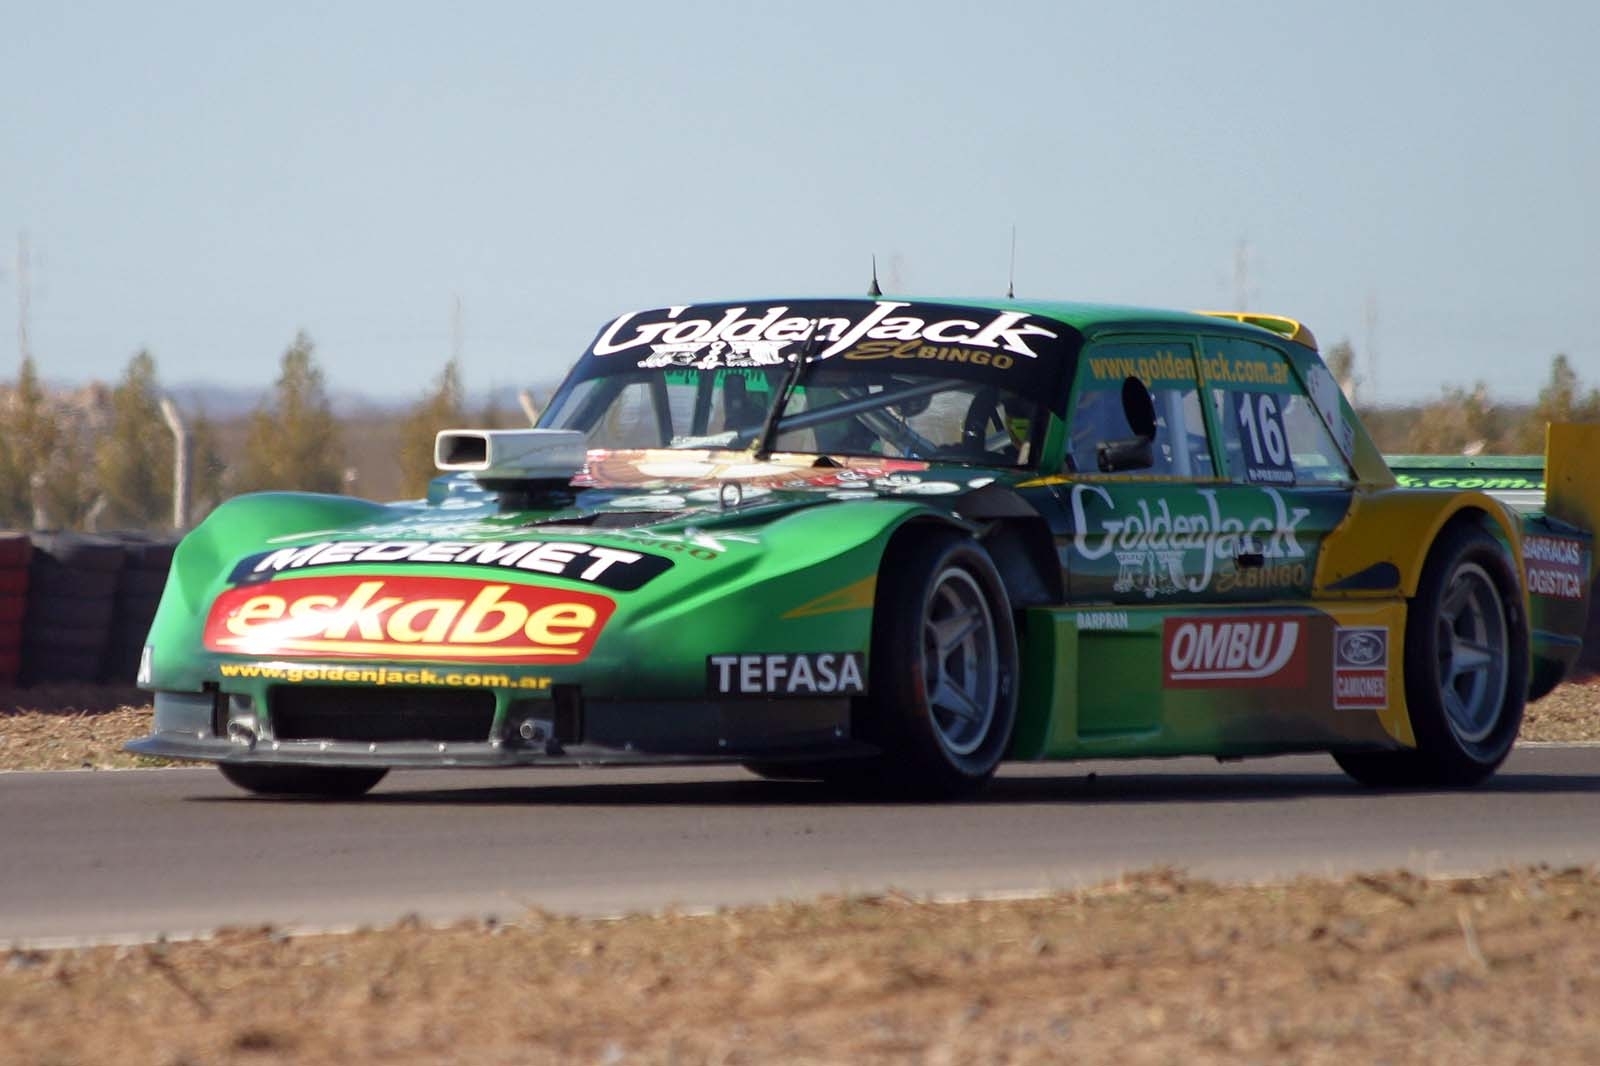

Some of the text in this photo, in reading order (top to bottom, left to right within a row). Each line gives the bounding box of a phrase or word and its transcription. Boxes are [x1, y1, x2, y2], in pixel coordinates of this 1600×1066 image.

[593, 301, 1059, 359] GoldenJack
[917, 346, 1014, 370] BINGO
[1239, 393, 1286, 467] 16
[253, 541, 642, 581] MEDEMET
[1071, 484, 1311, 593] GoldenJack
[226, 581, 598, 646] eskabe
[1170, 621, 1299, 672] OMBU
[220, 663, 553, 689] www.goldenjack.com.ar
[711, 654, 865, 694] TEFASA
